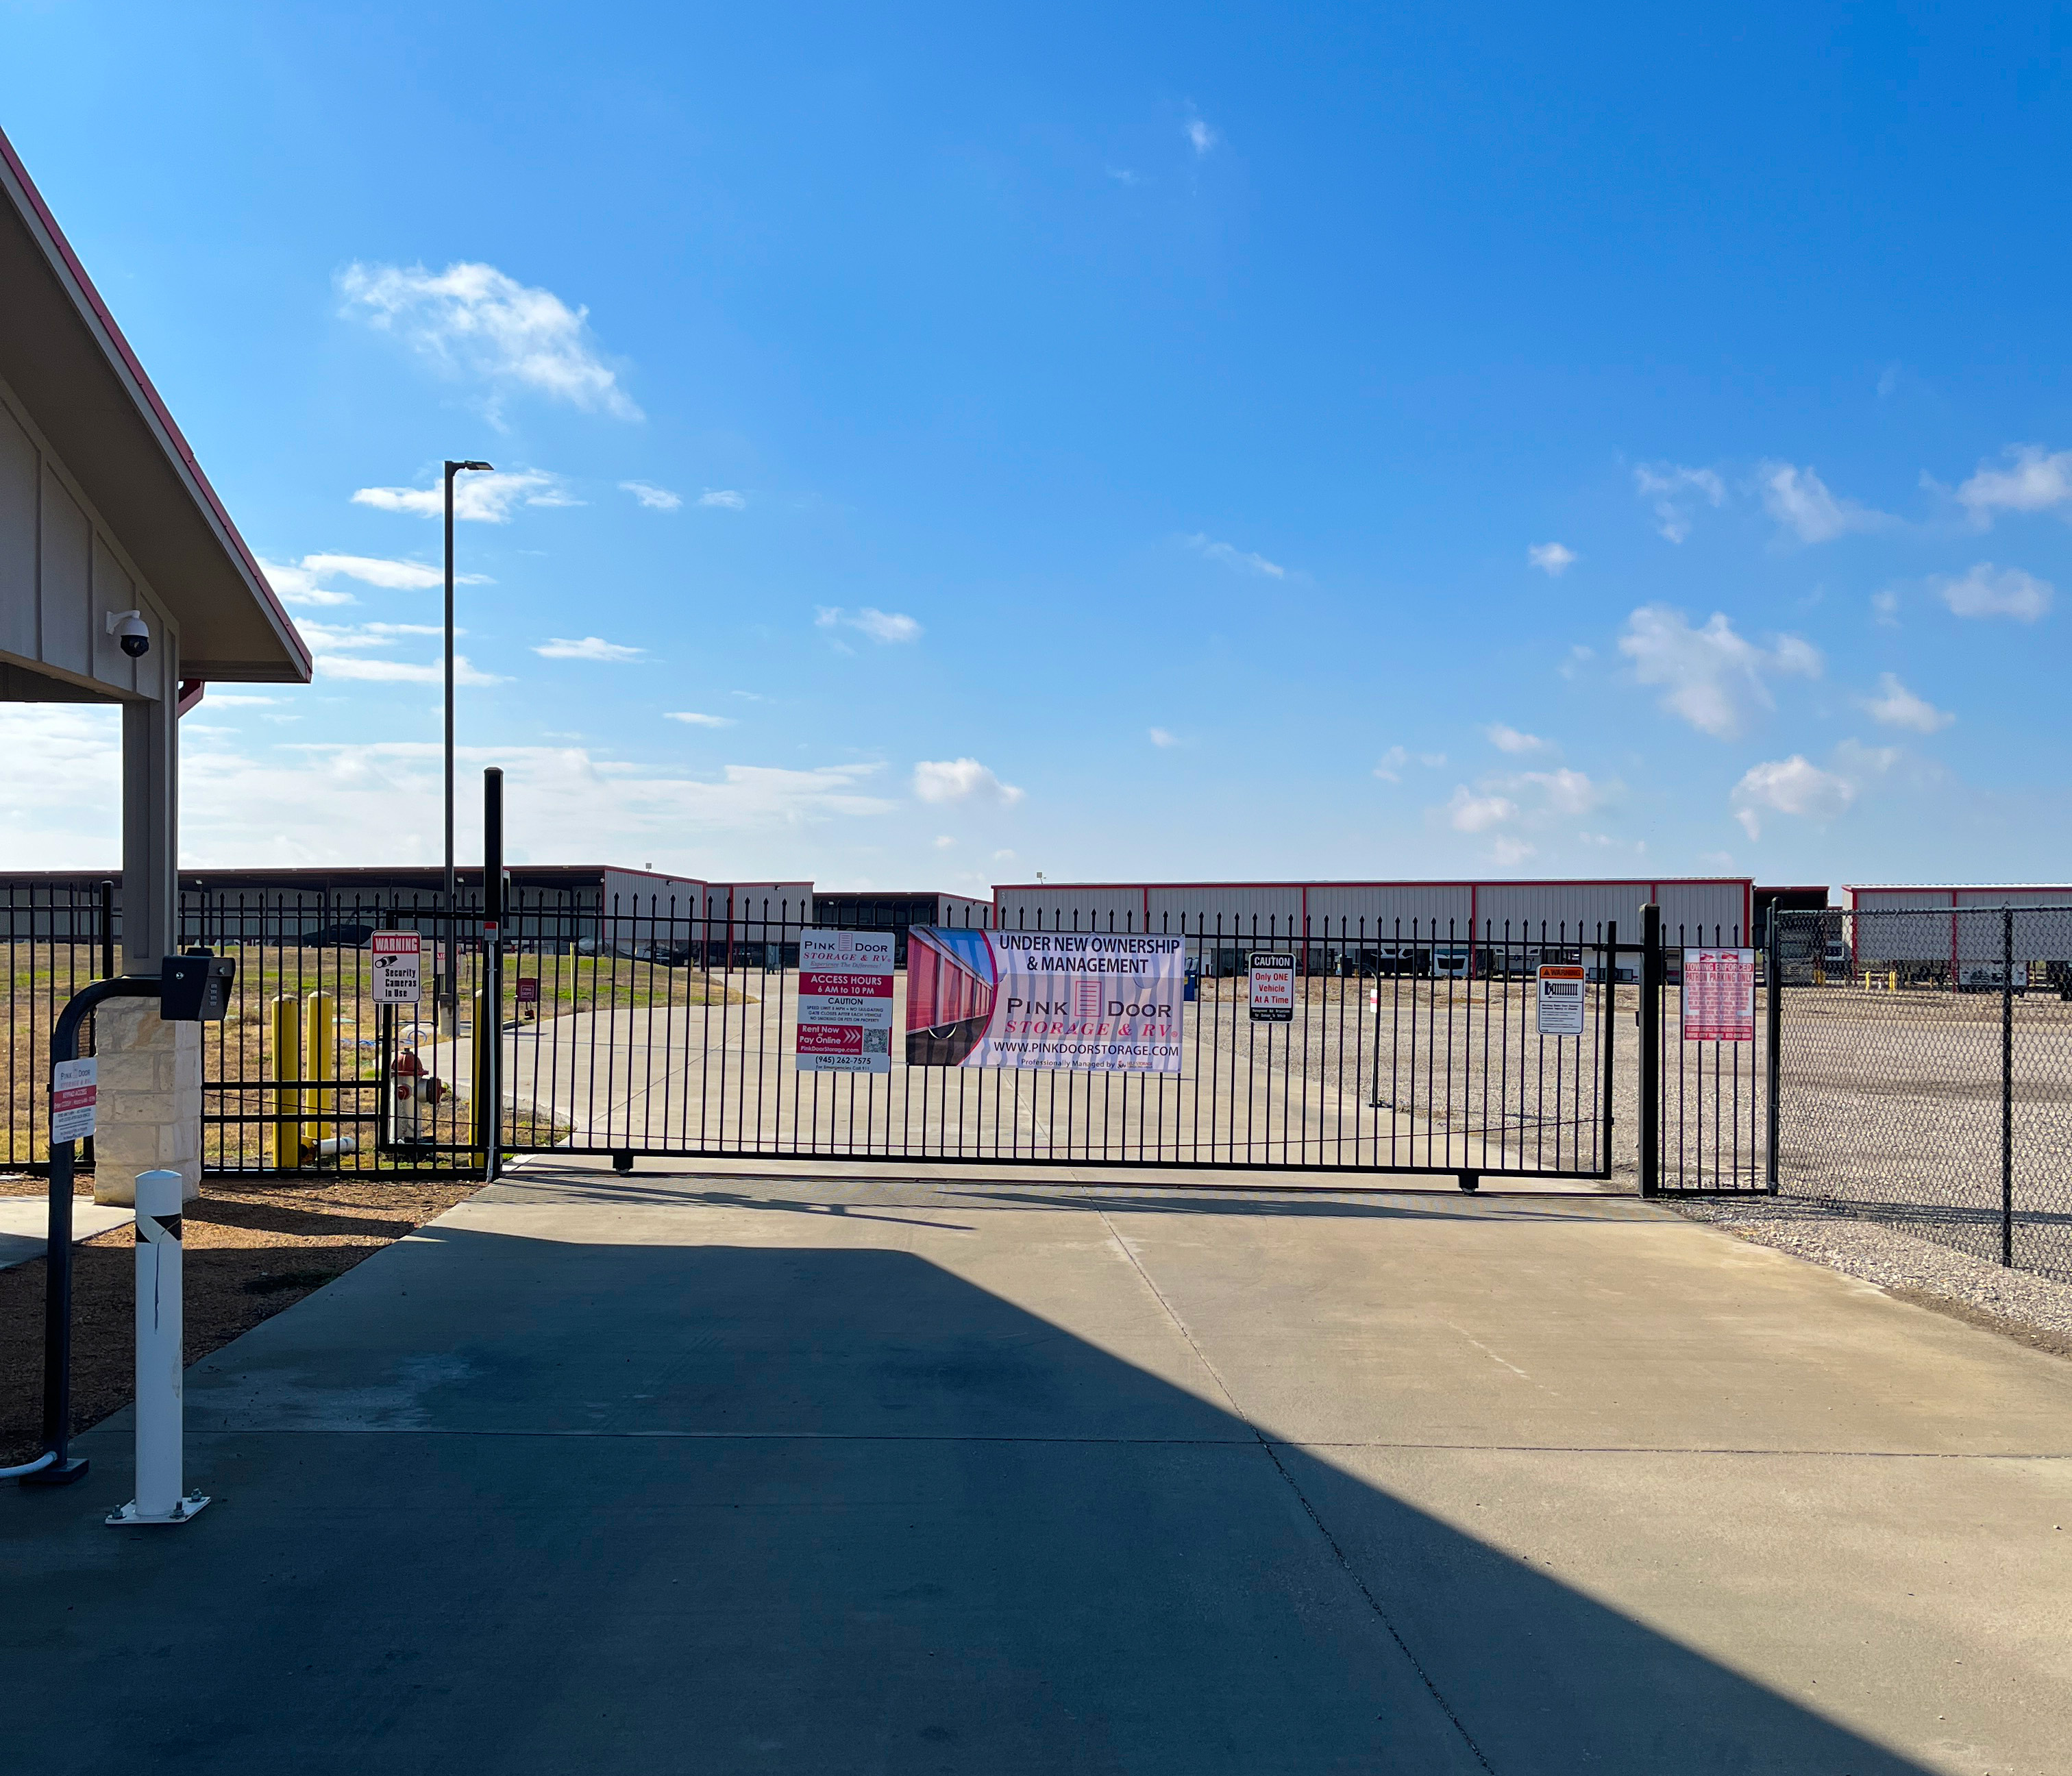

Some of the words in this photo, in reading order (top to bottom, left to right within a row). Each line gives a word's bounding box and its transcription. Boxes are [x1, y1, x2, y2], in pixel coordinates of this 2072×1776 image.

[375, 938, 417, 951] WARNING
[804, 941, 835, 950] PINK
[855, 943, 888, 952] DOOR
[999, 935, 1051, 952] UNDER
[1054, 937, 1089, 952] NEW
[1092, 937, 1180, 954] OWNERSHIP
[803, 952, 856, 961] STORAGE
[1255, 957, 1290, 966] CAUTION
[1027, 956, 1038, 971] &
[1041, 957, 1148, 974] MANAGEMENT
[386, 969, 415, 978] Security
[1255, 973, 1271, 982] Only
[1686, 973, 1707, 982] PATRON
[1710, 973, 1736, 982] PARKING
[1738, 973, 1753, 982] ONLY
[811, 974, 848, 985] ACCESS
[851, 976, 882, 985] HOURS
[1007, 998, 1069, 1016] PINK
[1108, 1000, 1172, 1018] DOOR
[1005, 1020, 1110, 1037] STORAGE
[1118, 1022, 1132, 1037] &
[800, 1036, 814, 1044] Pay
[994, 1041, 1179, 1057] WWW.PINKDOORSTORAGE.COM
[815, 1056, 835, 1064] (945)
[837, 1057, 871, 1065] 262-7575
[1021, 1059, 1070, 1068] Professionally
[1072, 1060, 1100, 1069] Managed
[1102, 1060, 1115, 1070] by
